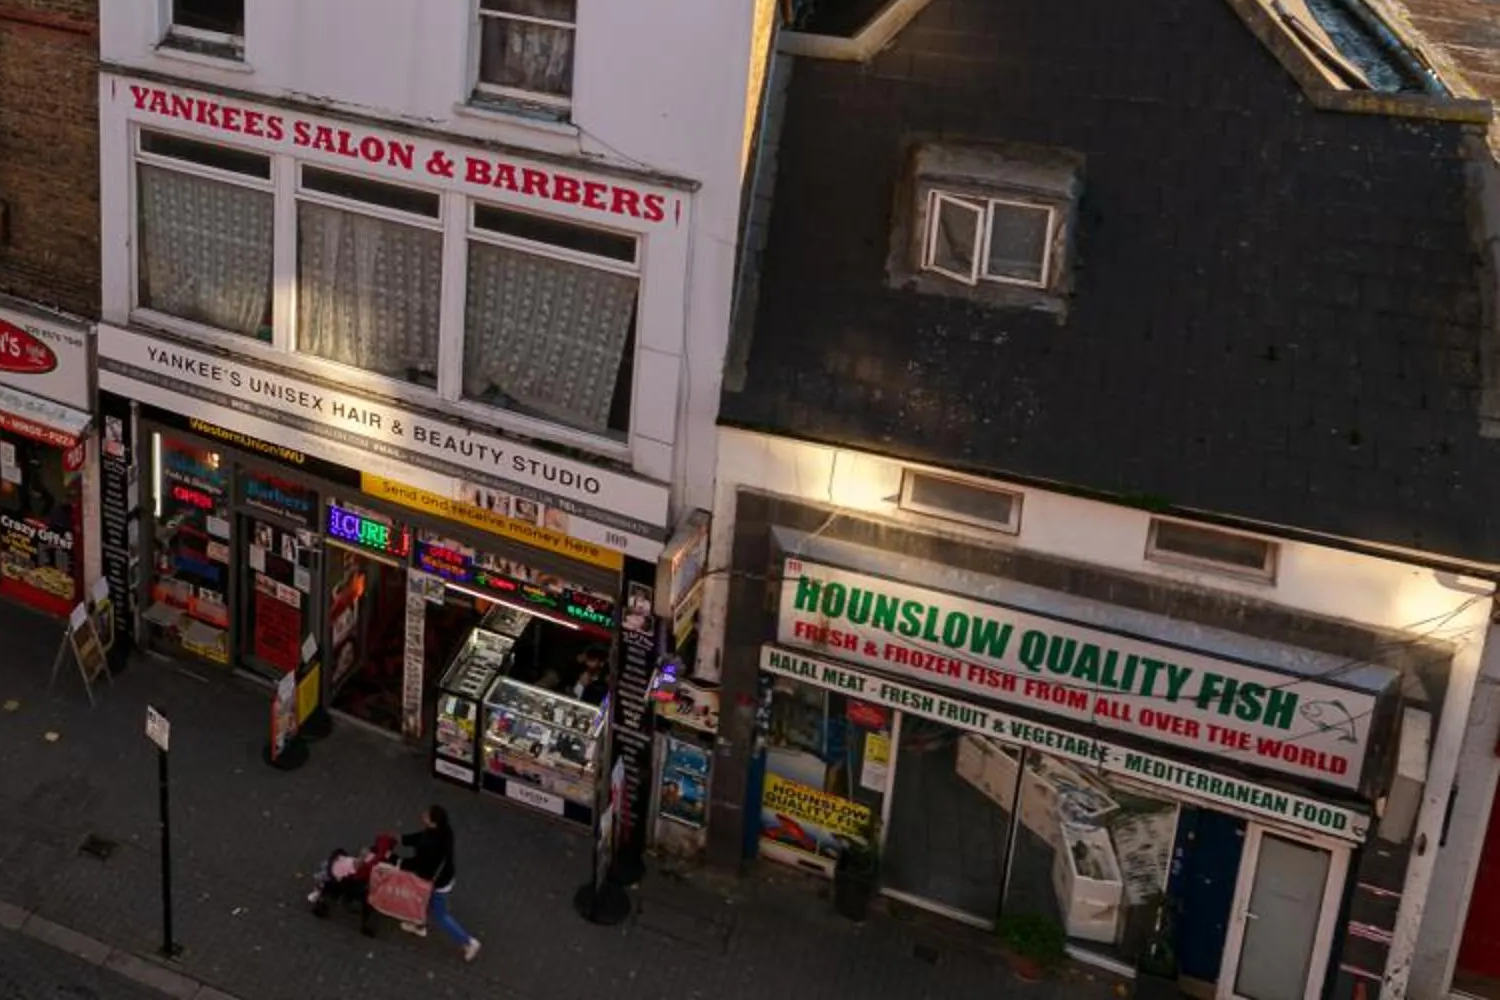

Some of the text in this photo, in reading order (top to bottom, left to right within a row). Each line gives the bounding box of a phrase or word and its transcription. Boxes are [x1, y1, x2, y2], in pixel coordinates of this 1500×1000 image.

[130, 85, 666, 222] YANKEES SALON & BARBERS
[147, 346, 241, 387] YANKEE'S
[249, 377, 324, 412] UNISEX
[332, 402, 383, 429] HAIR
[391, 420, 405, 436] &
[413, 425, 505, 465] BEAUTY
[512, 455, 601, 494] STUDIO
[509, 520, 561, 548] money
[564, 535, 600, 558] here
[794, 574, 1299, 730] HOUNSLOW QUALITY FISH
[794, 619, 1348, 776] FRESH & FROZEN FISH FROM ALL OVER THE WORLD
[768, 650, 817, 680] HALAL
[821, 666, 868, 693] MEAT
[879, 683, 934, 714] FRESH
[937, 698, 989, 730] FRUIT
[993, 718, 1006, 733] &
[1009, 722, 1111, 764] VEGETABLE
[1124, 752, 1289, 815] MEDITERRANEAN
[1291, 799, 1348, 832] FOOD
